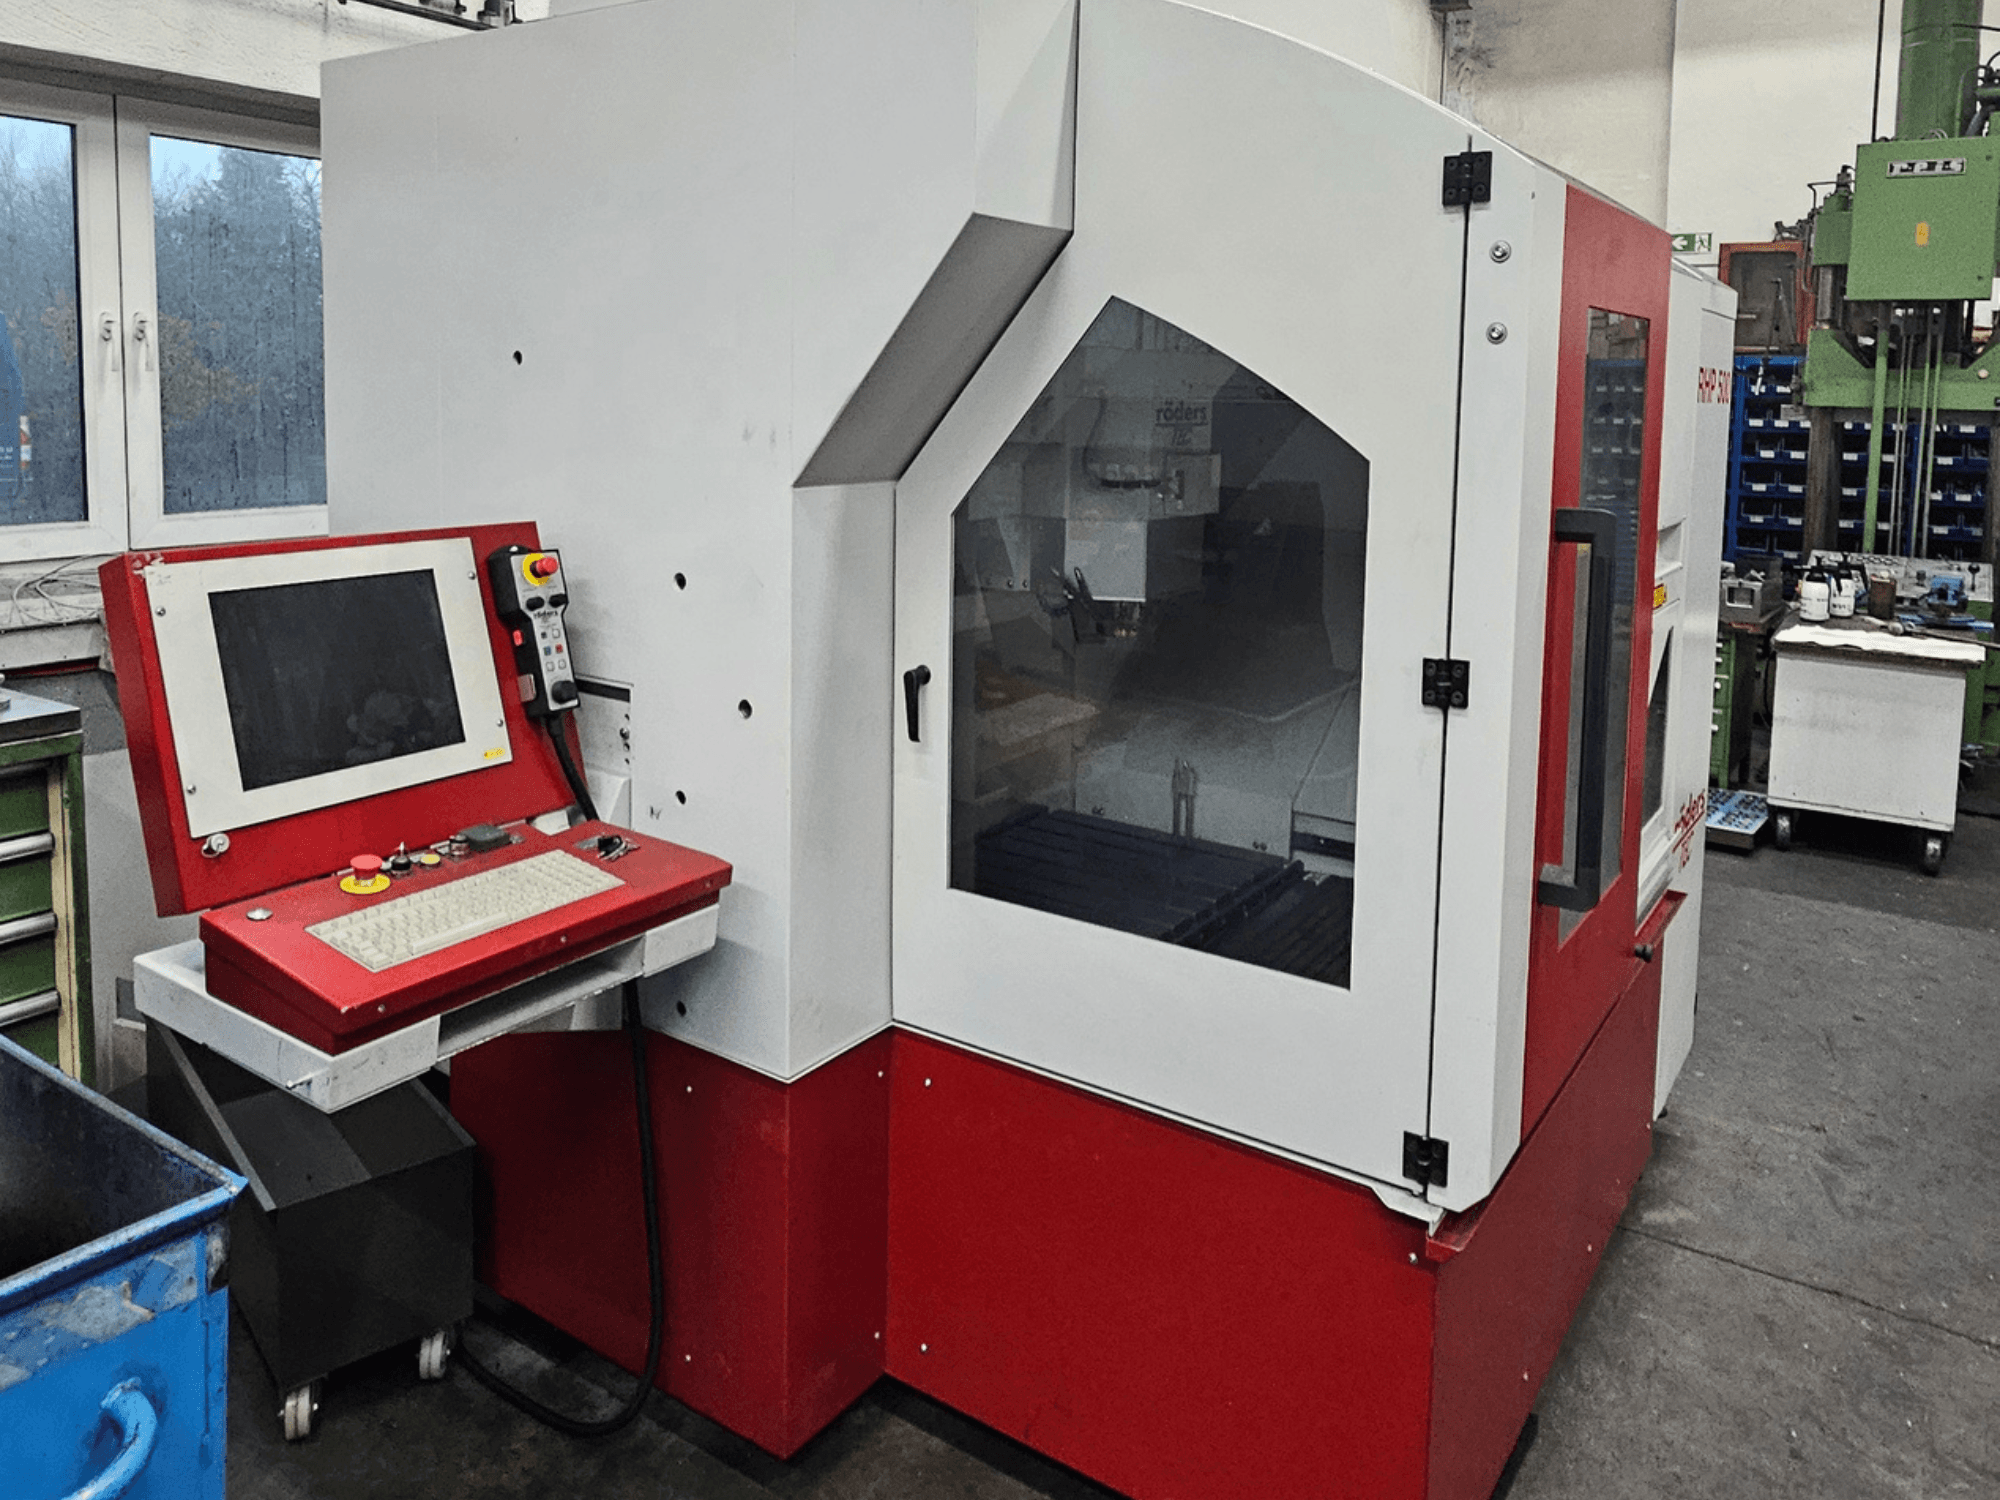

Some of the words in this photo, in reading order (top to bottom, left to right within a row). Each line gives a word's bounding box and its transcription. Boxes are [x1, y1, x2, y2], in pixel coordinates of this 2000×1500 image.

[1697, 366, 1717, 403] RHP
[1717, 370, 1731, 404] 500
[1155, 400, 1208, 421] röders
